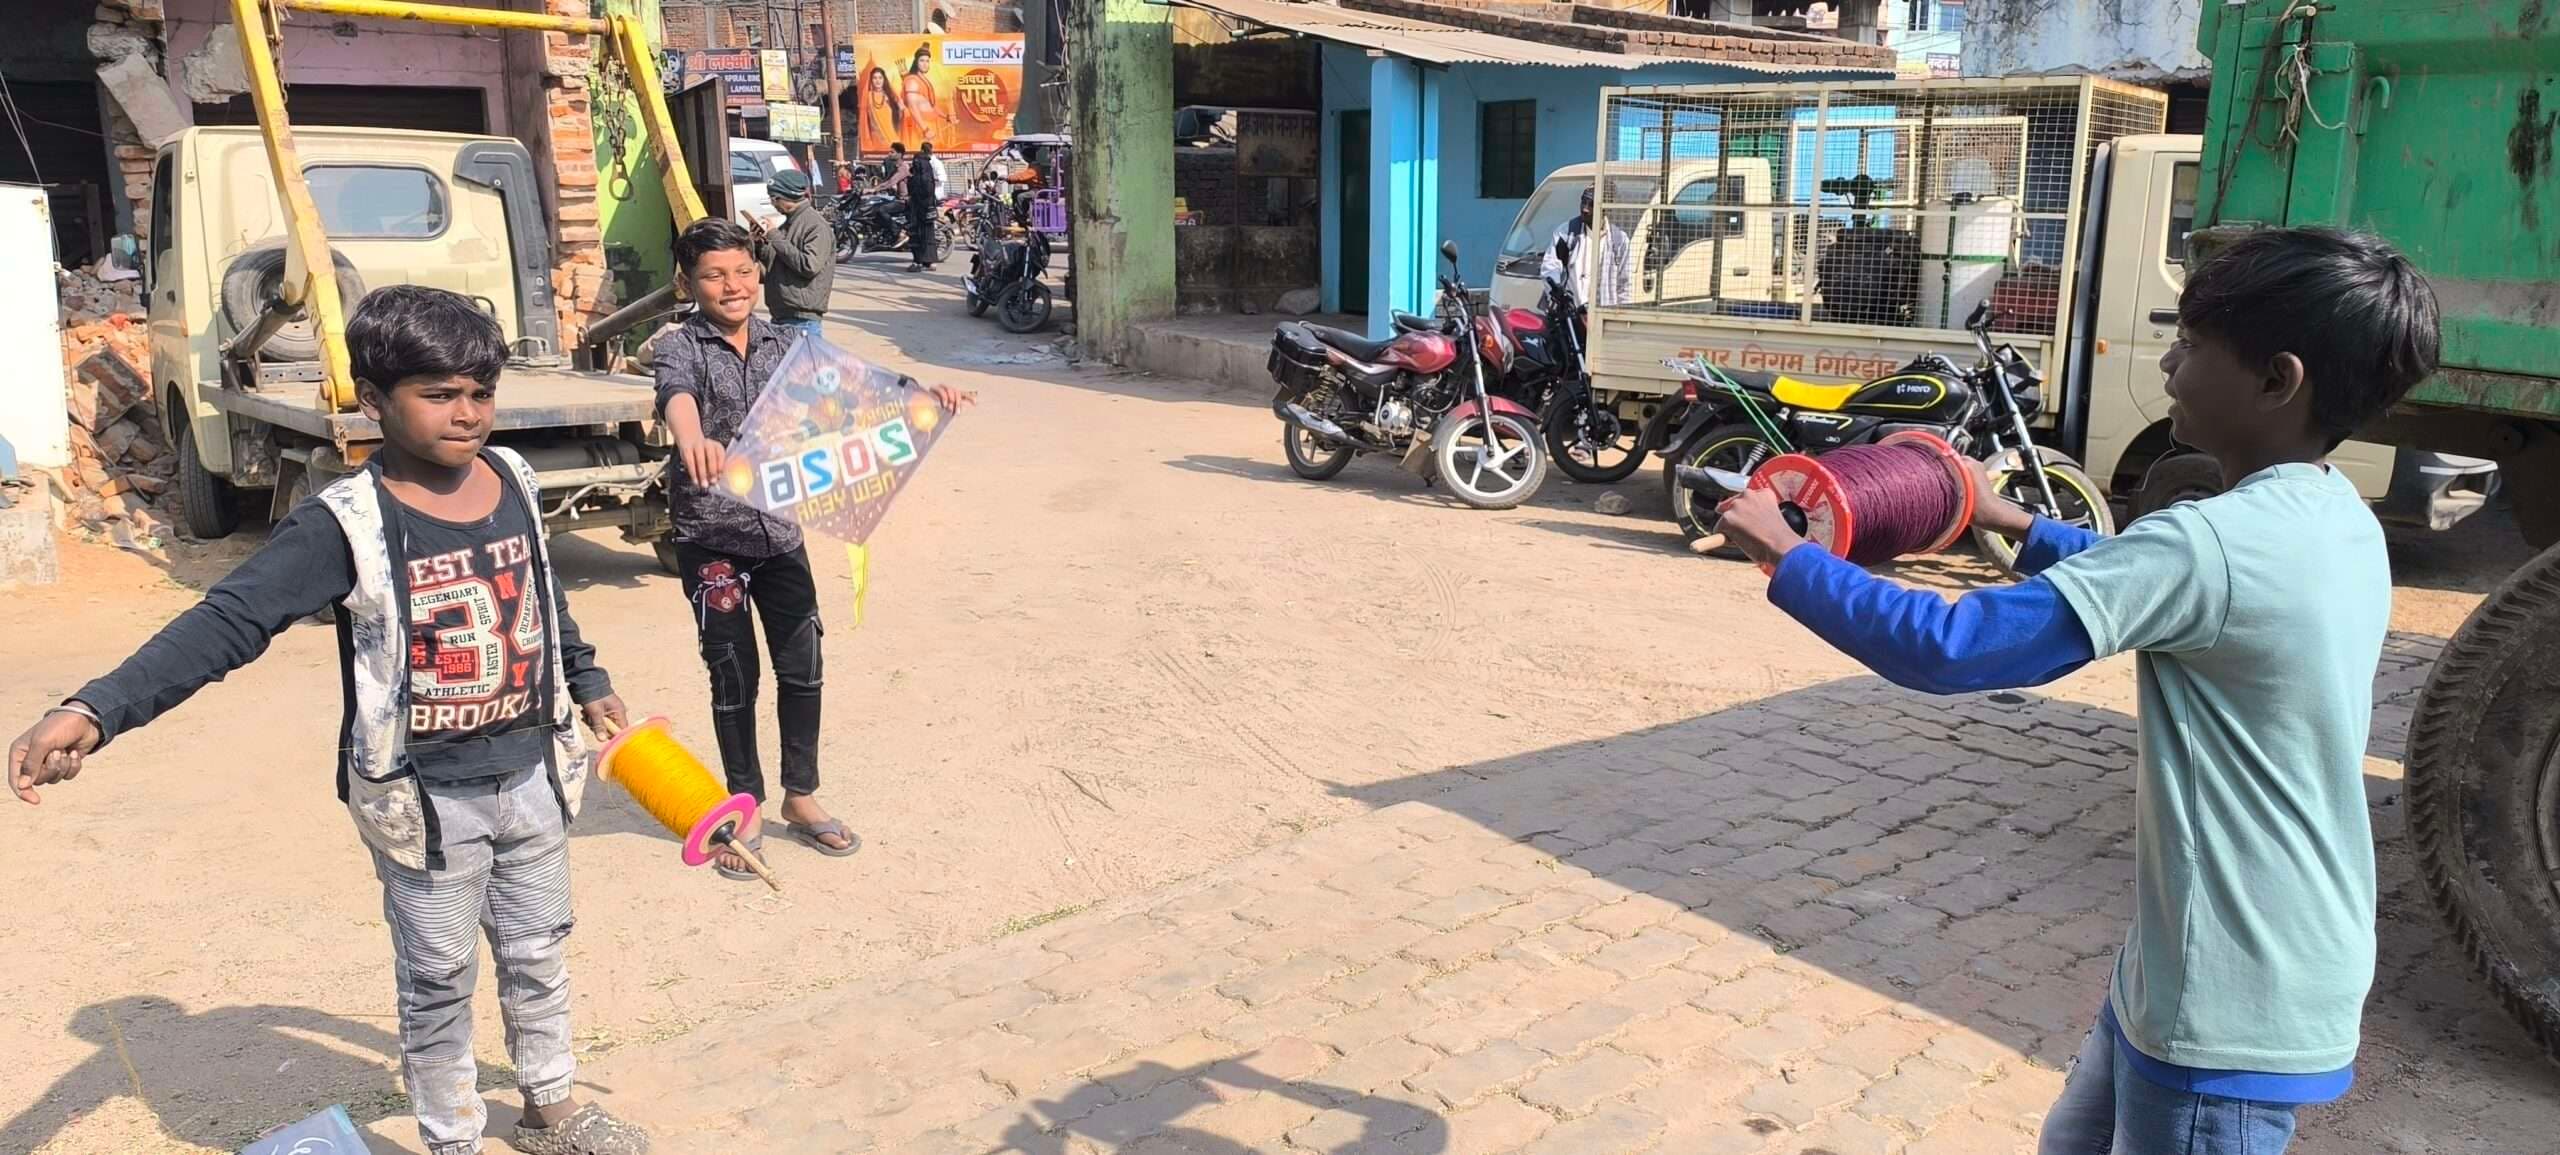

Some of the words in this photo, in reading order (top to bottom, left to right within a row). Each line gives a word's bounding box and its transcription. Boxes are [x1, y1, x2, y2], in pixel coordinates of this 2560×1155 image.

[687, 51, 706, 70] श्री
[945, 43, 1022, 58] TUFCONXT
[1741, 344, 1804, 371] निगम
[408, 547, 474, 589] EST
[413, 586, 480, 607] LEGENDARY
[473, 597, 492, 625] SPIRIT
[449, 632, 477, 646] RUN
[435, 652, 475, 664] ESTD.
[486, 642, 498, 677] FASTER
[424, 684, 490, 697] ATHLETIC
